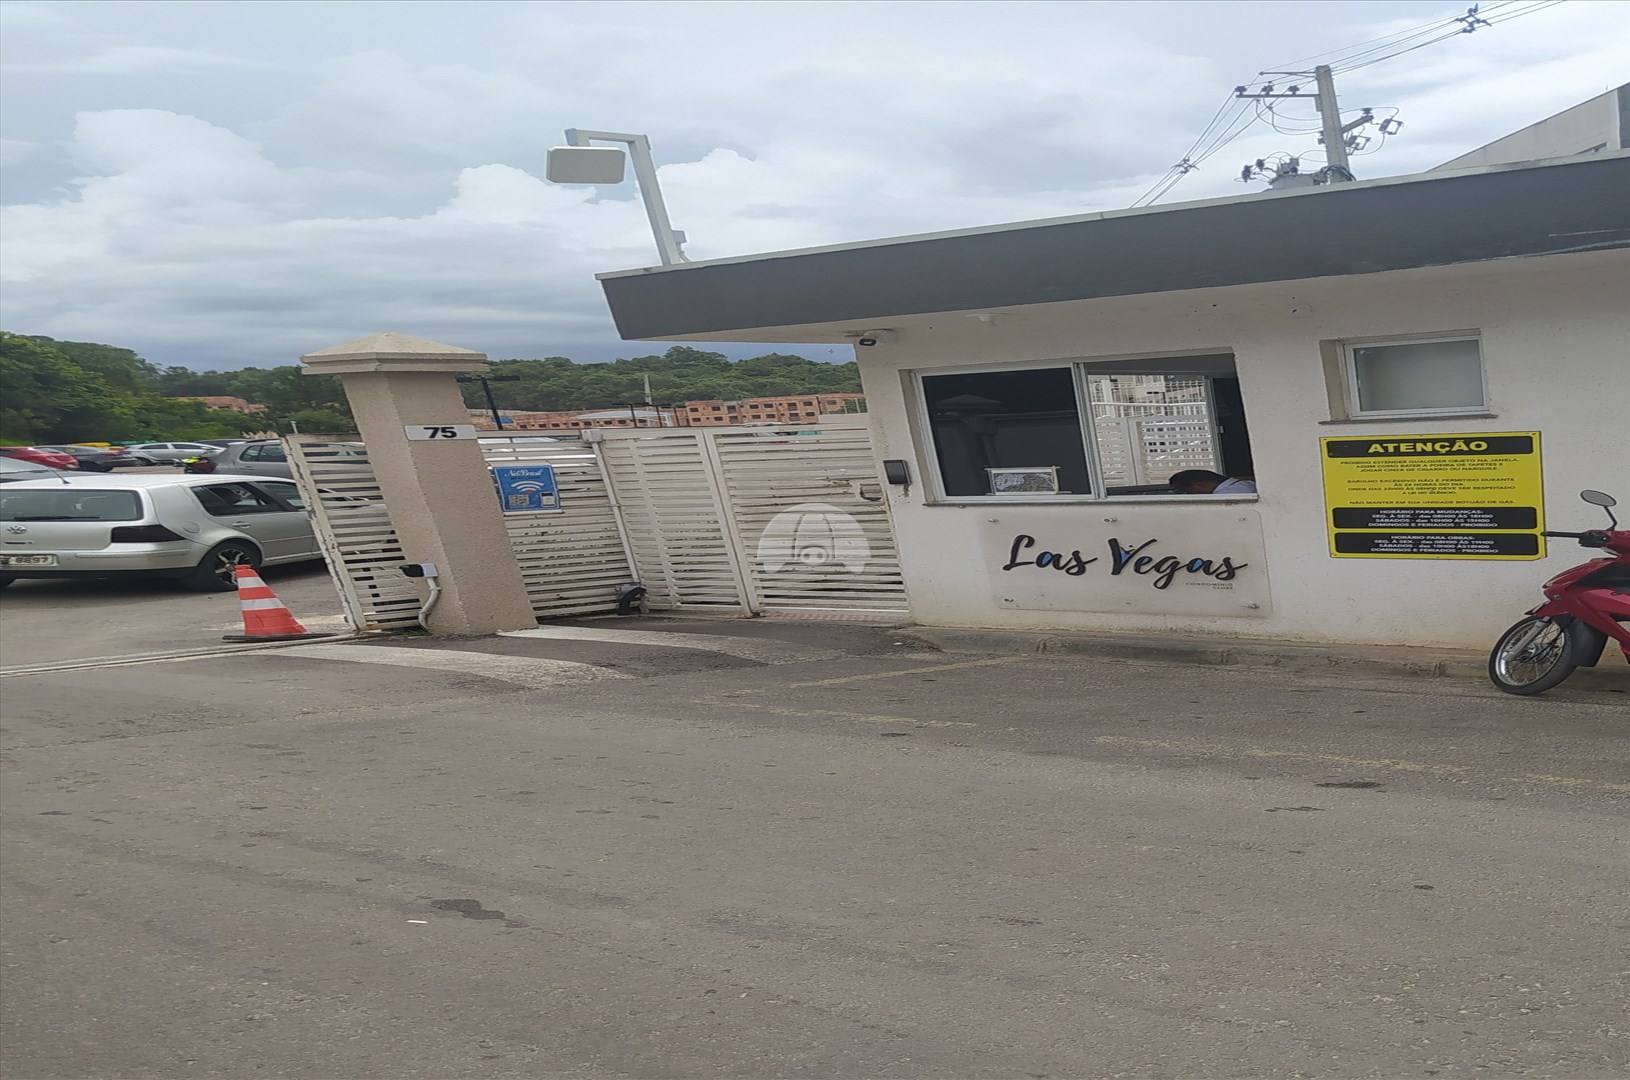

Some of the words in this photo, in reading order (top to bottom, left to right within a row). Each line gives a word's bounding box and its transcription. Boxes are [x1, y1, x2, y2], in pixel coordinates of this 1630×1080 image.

[424, 427, 457, 438] 75
[1368, 439, 1488, 454] ATENÇÃO
[1002, 535, 1098, 576] Las
[1108, 538, 1248, 589] Vegas
